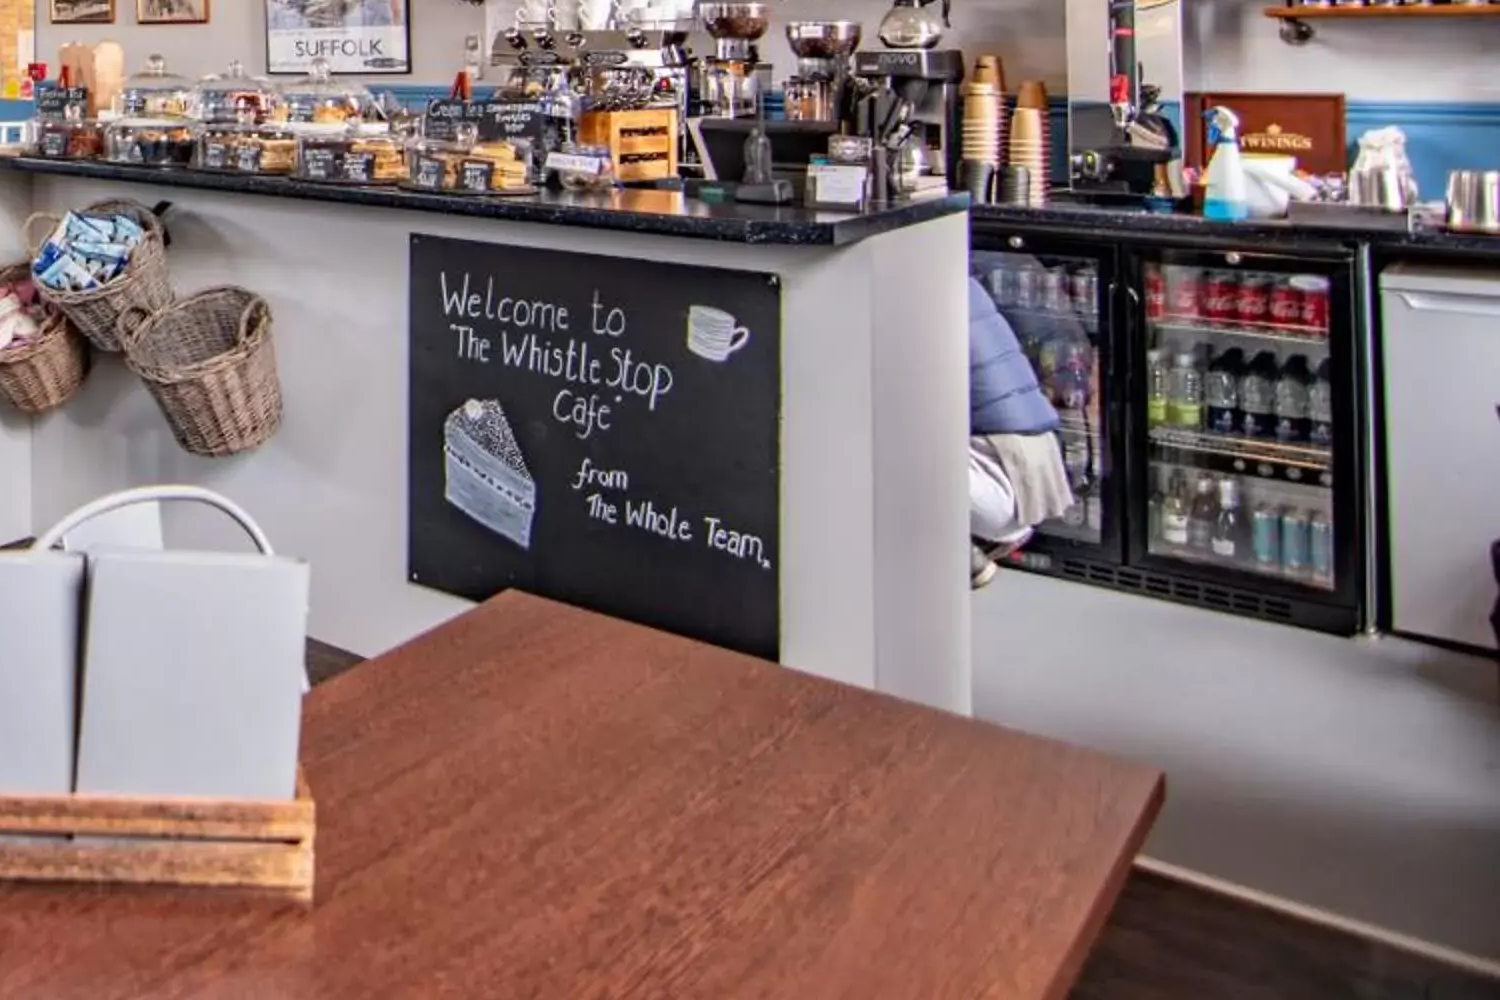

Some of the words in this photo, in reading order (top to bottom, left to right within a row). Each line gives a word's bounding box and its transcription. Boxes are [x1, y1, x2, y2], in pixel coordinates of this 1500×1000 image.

[295, 39, 384, 57] SUFFOLK
[439, 272, 570, 331] Welcome
[592, 290, 626, 337] to
[450, 323, 491, 361] The
[501, 331, 601, 385] Whistle
[606, 347, 674, 410] Stop
[572, 458, 629, 490] from
[586, 494, 617, 524] The
[625, 500, 693, 541] Whole
